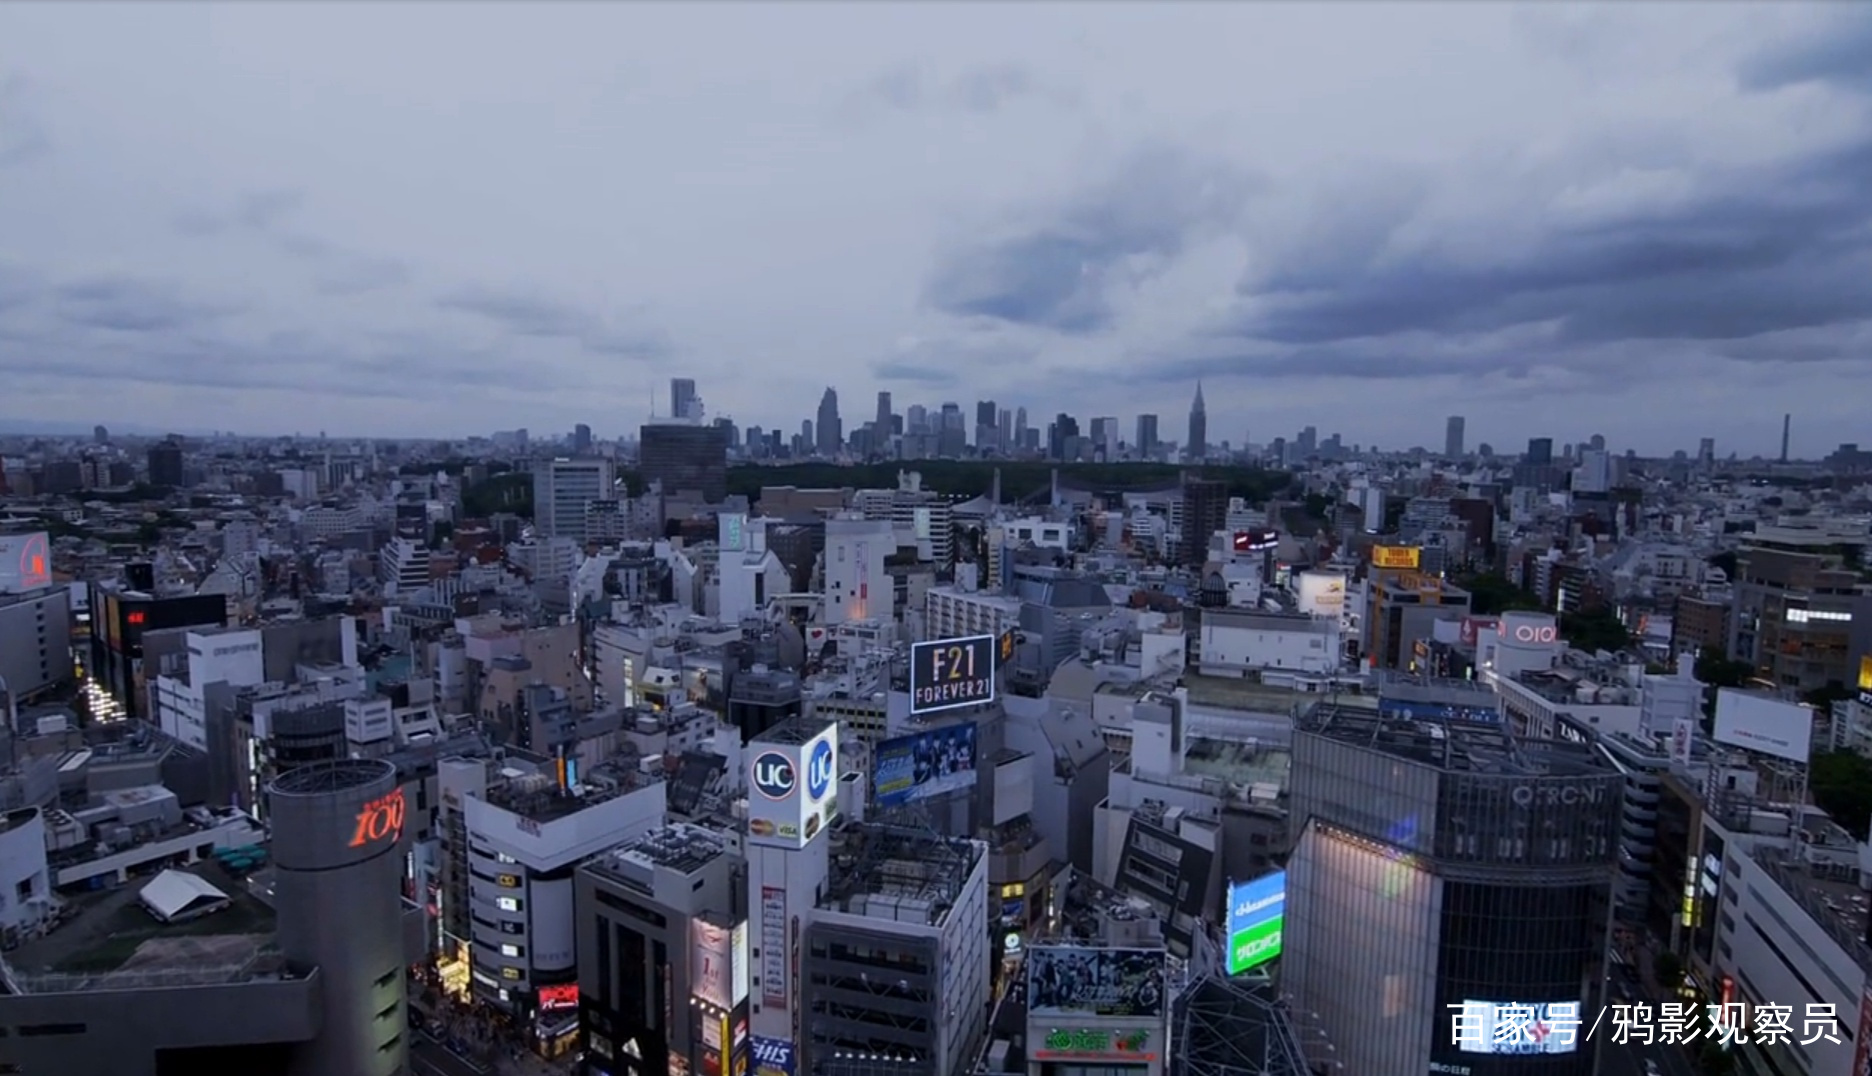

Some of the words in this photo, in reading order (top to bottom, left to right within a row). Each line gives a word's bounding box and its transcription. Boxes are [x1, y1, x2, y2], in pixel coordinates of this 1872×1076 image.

[932, 644, 975, 682] F21
[915, 681, 975, 705] FOREVER
[976, 677, 990, 697] 21
[755, 762, 794, 789] UC
[347, 794, 405, 849] 109
